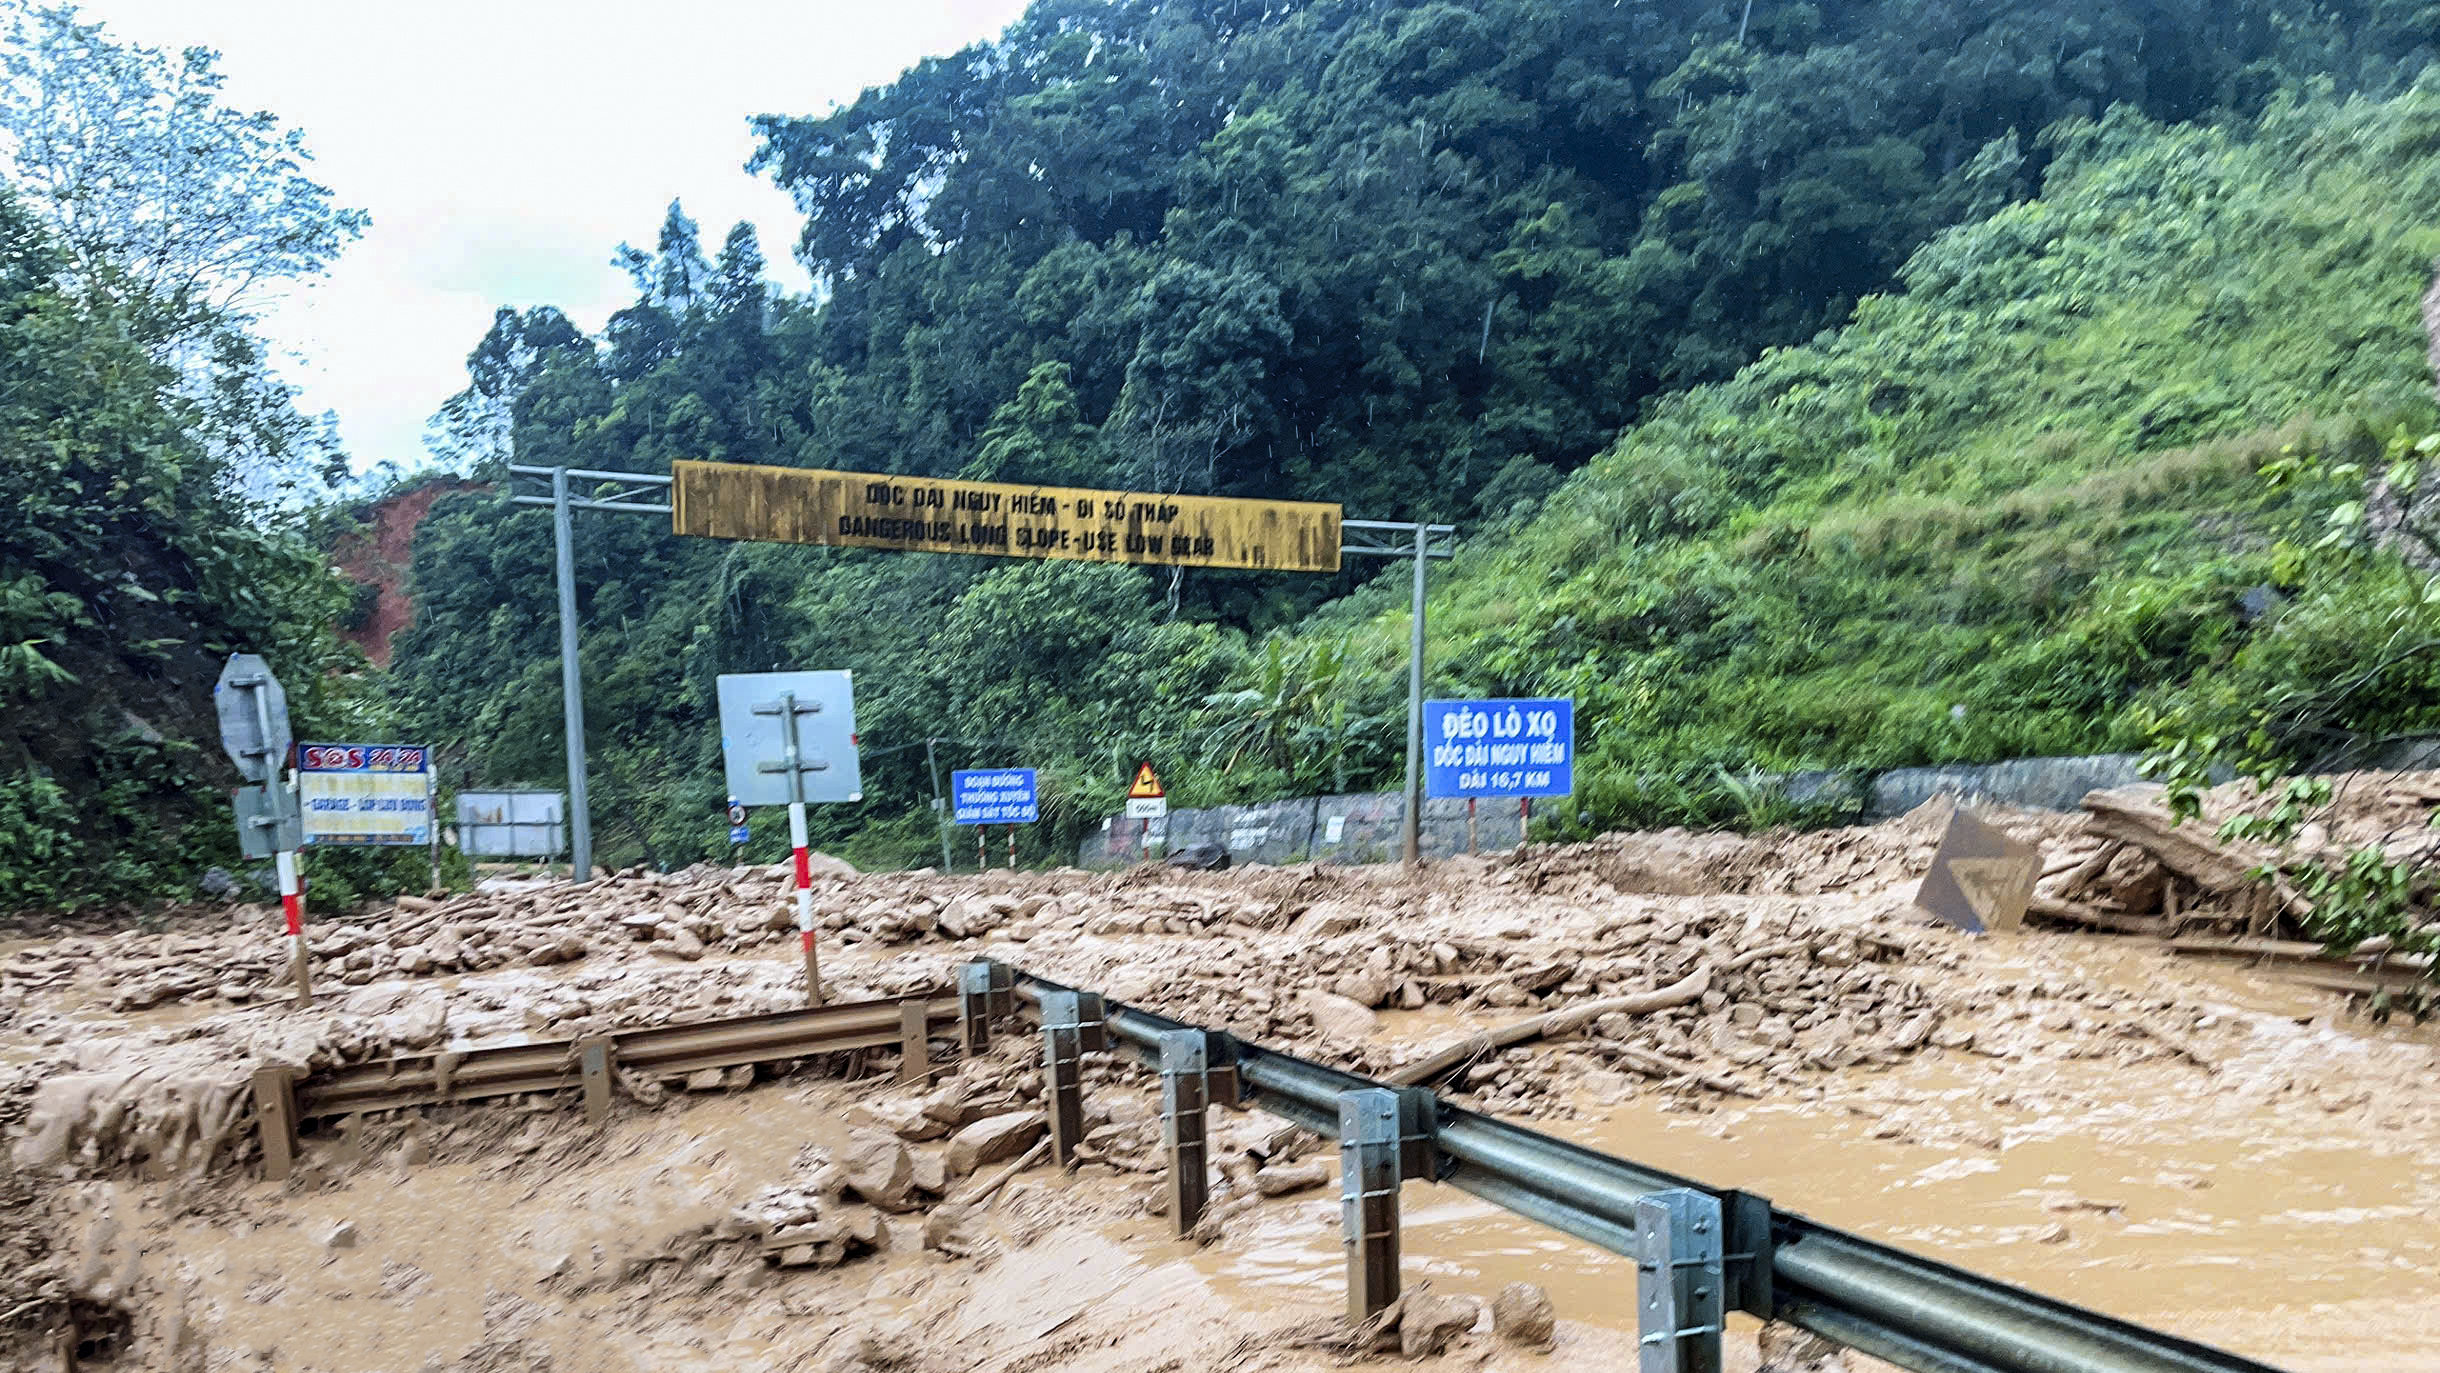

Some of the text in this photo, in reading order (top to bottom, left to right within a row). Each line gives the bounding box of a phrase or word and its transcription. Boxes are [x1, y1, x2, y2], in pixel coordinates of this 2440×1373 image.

[952, 490, 1001, 513] NGUY
[839, 515, 952, 543] DANGEROUS
[959, 522, 1009, 546] LONG
[1125, 533, 1163, 555] LOW
[303, 746, 366, 770] SOS
[1490, 743, 1529, 766] NGUY
[1490, 770, 1523, 792] 16,7
[1524, 770, 1551, 789] KM
